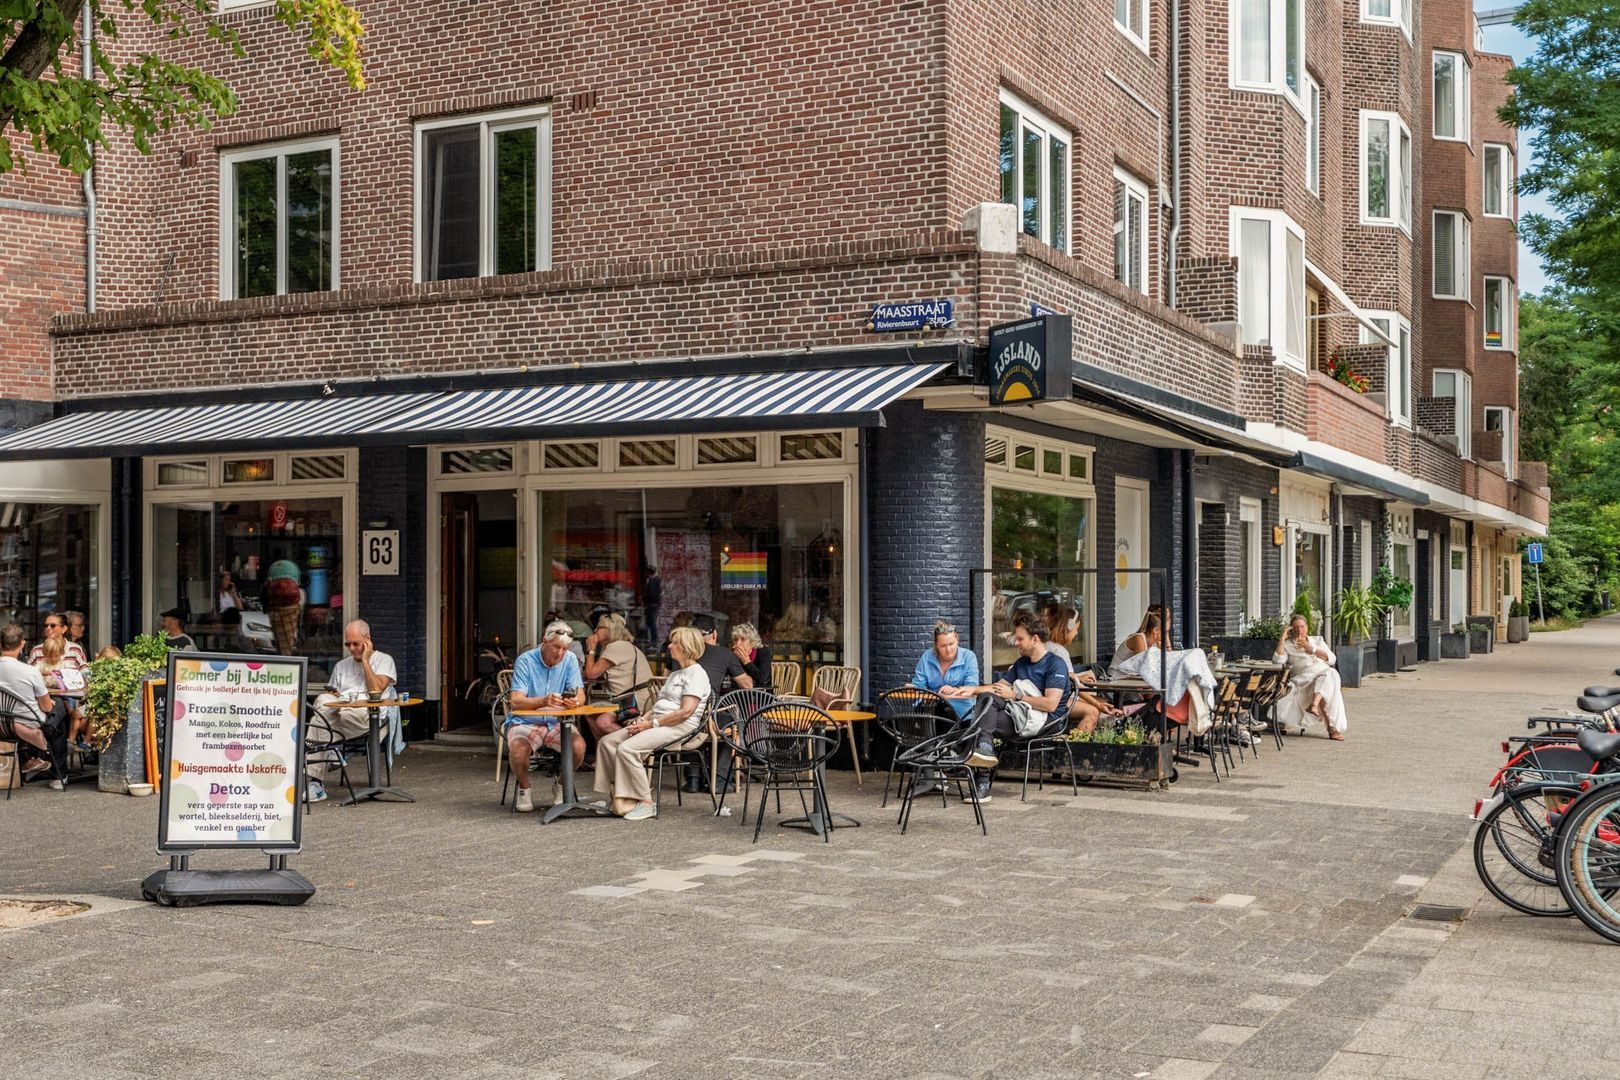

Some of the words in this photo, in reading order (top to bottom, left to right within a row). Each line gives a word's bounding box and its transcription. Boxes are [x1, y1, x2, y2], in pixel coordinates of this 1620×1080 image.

[877, 303, 947, 318] MAASSTRAAT
[877, 320, 919, 328] Rivierenbuurt
[994, 340, 1041, 379] IJSLAND
[370, 537, 392, 565] 63
[180, 668, 221, 682] Zomer
[226, 669, 241, 685] bij
[247, 671, 293, 685] IJsland
[176, 684, 204, 692] Gebruik
[212, 686, 240, 695] bolletje!
[253, 687, 261, 695] ijs
[262, 688, 272, 696] bij
[188, 703, 227, 715] Frozen
[229, 704, 283, 716] Smoothie
[188, 719, 217, 729] Mango,
[218, 720, 244, 729] Kokos,
[245, 721, 280, 730] Roodfruit
[227, 731, 260, 741] heerlijke
[202, 742, 266, 751] frambozensorbet
[177, 763, 244, 775] Huisgemaakte
[246, 764, 287, 774] IJskoffie
[209, 783, 251, 795] Detox
[243, 803, 258, 811] sap
[179, 813, 207, 821] wortel,
[208, 813, 263, 821] bleekselderij,
[264, 813, 282, 821] biet,
[235, 825, 266, 833] gember
